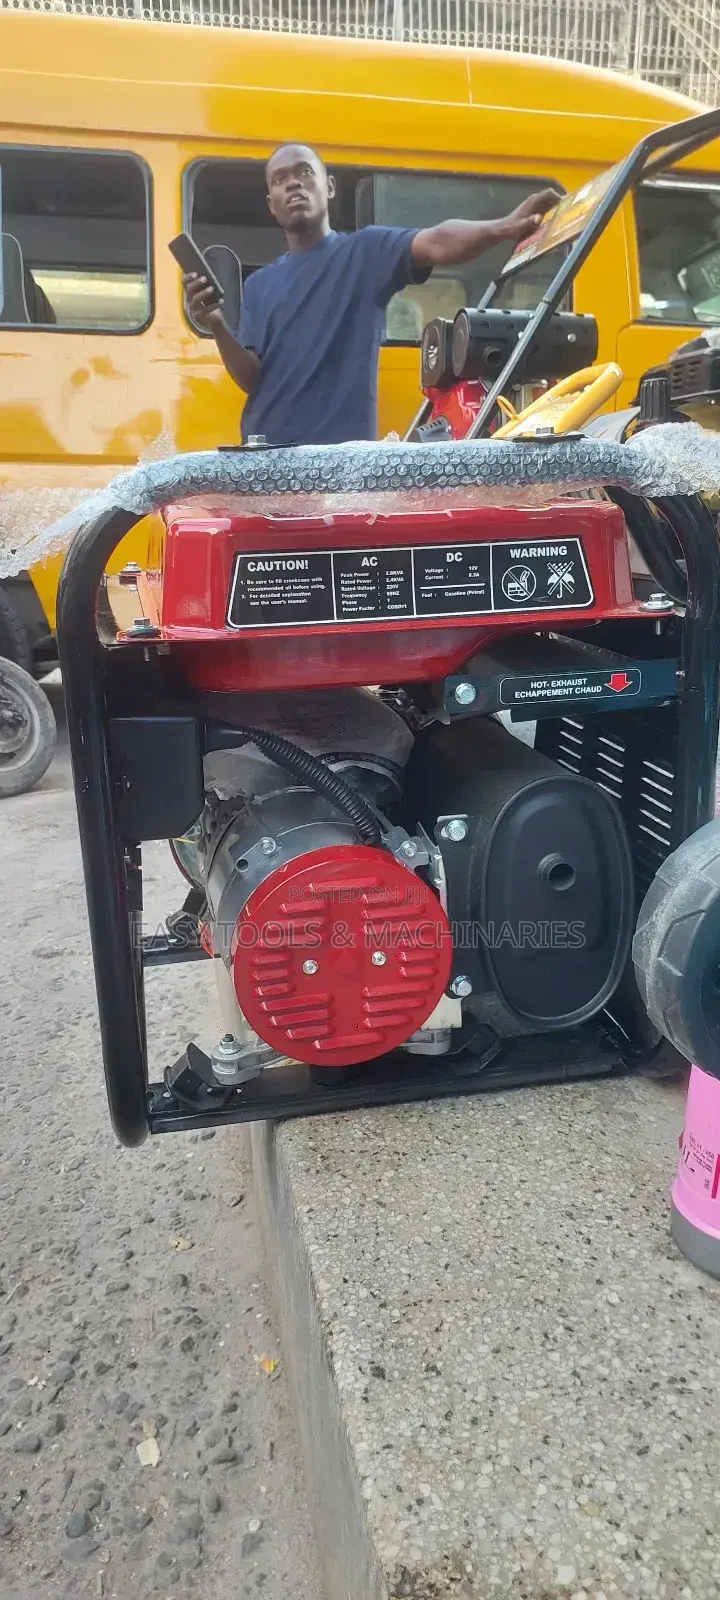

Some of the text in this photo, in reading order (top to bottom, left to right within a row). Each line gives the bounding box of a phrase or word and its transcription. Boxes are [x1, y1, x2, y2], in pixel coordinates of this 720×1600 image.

[446, 552, 463, 563] DC
[510, 546, 568, 559] WARNING
[247, 560, 309, 572] CAUTION!
[361, 556, 378, 567] AC
[531, 678, 588, 689] HOT- EXHAUST
[515, 685, 602, 699] ECHAPPEMENT CHAUD
